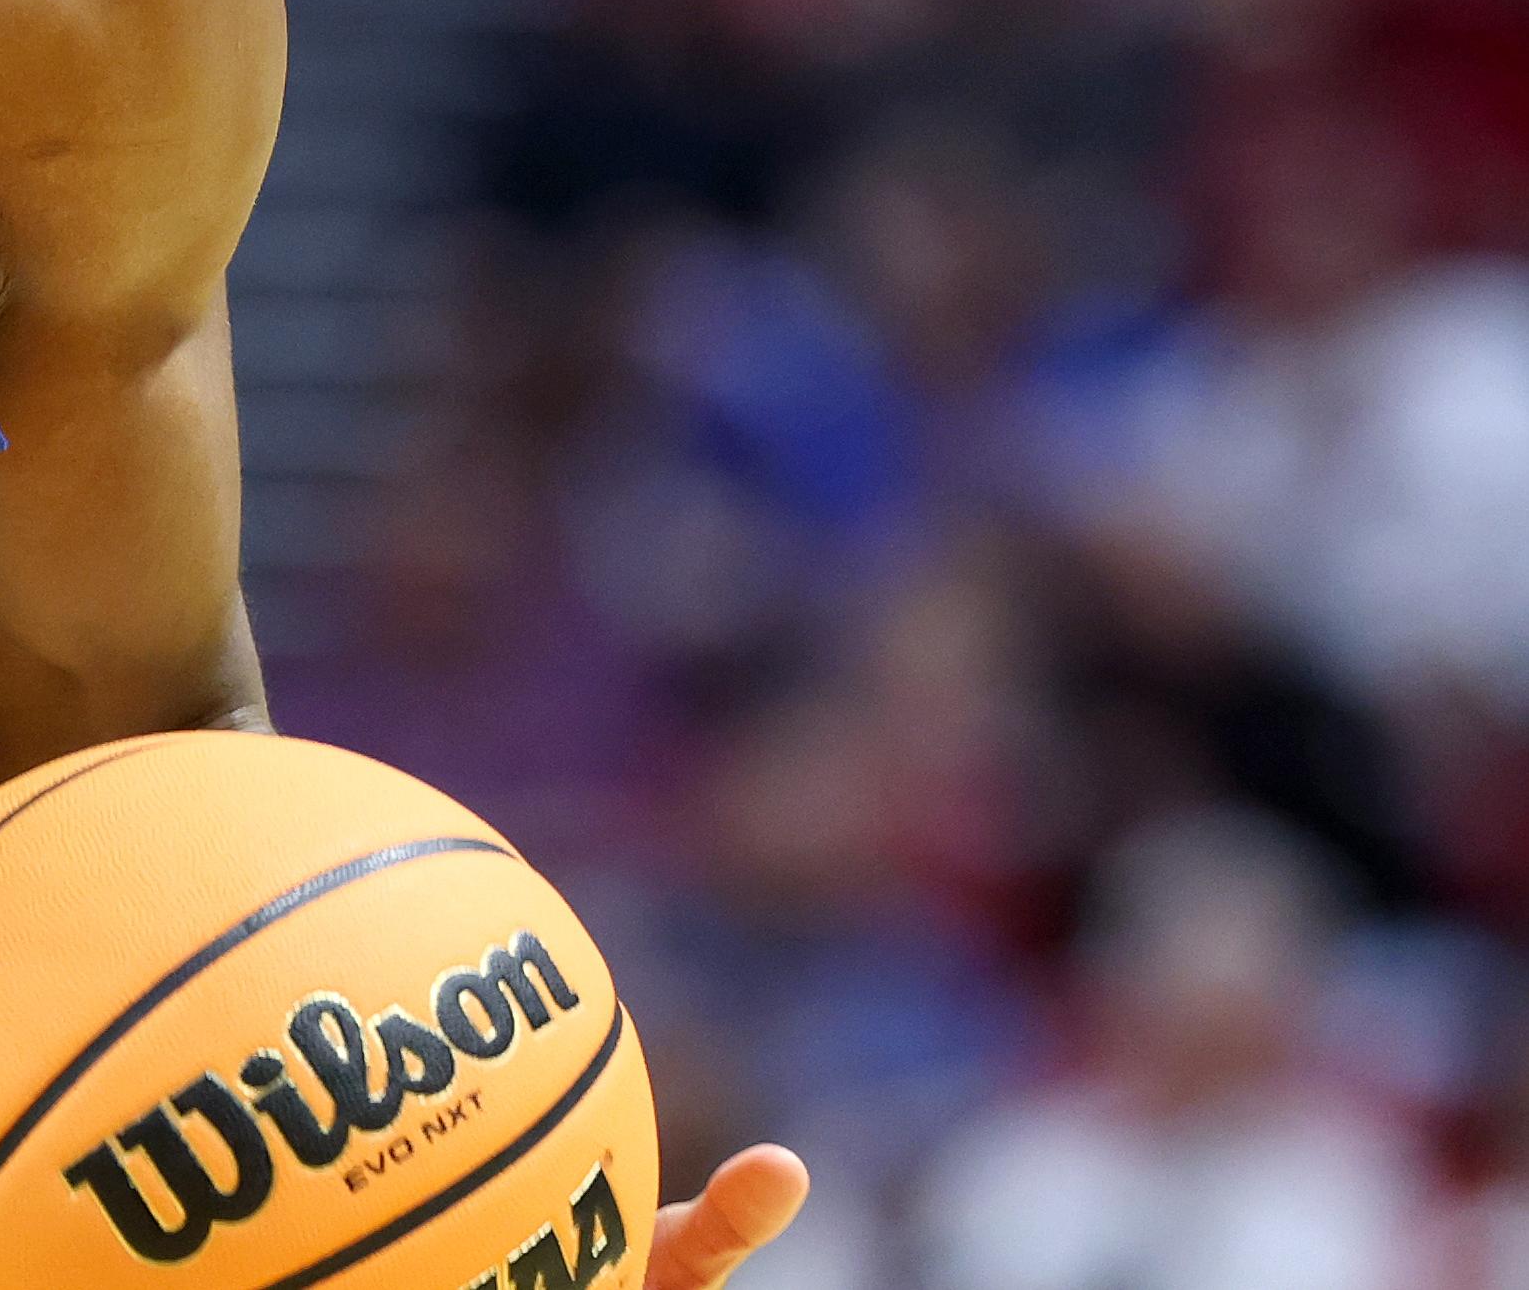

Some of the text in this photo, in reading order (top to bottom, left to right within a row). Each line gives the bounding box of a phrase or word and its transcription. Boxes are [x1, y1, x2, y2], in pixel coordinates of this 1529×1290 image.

[61, 929, 581, 1266] Wilson
[343, 1089, 483, 1194] EVO NXT
